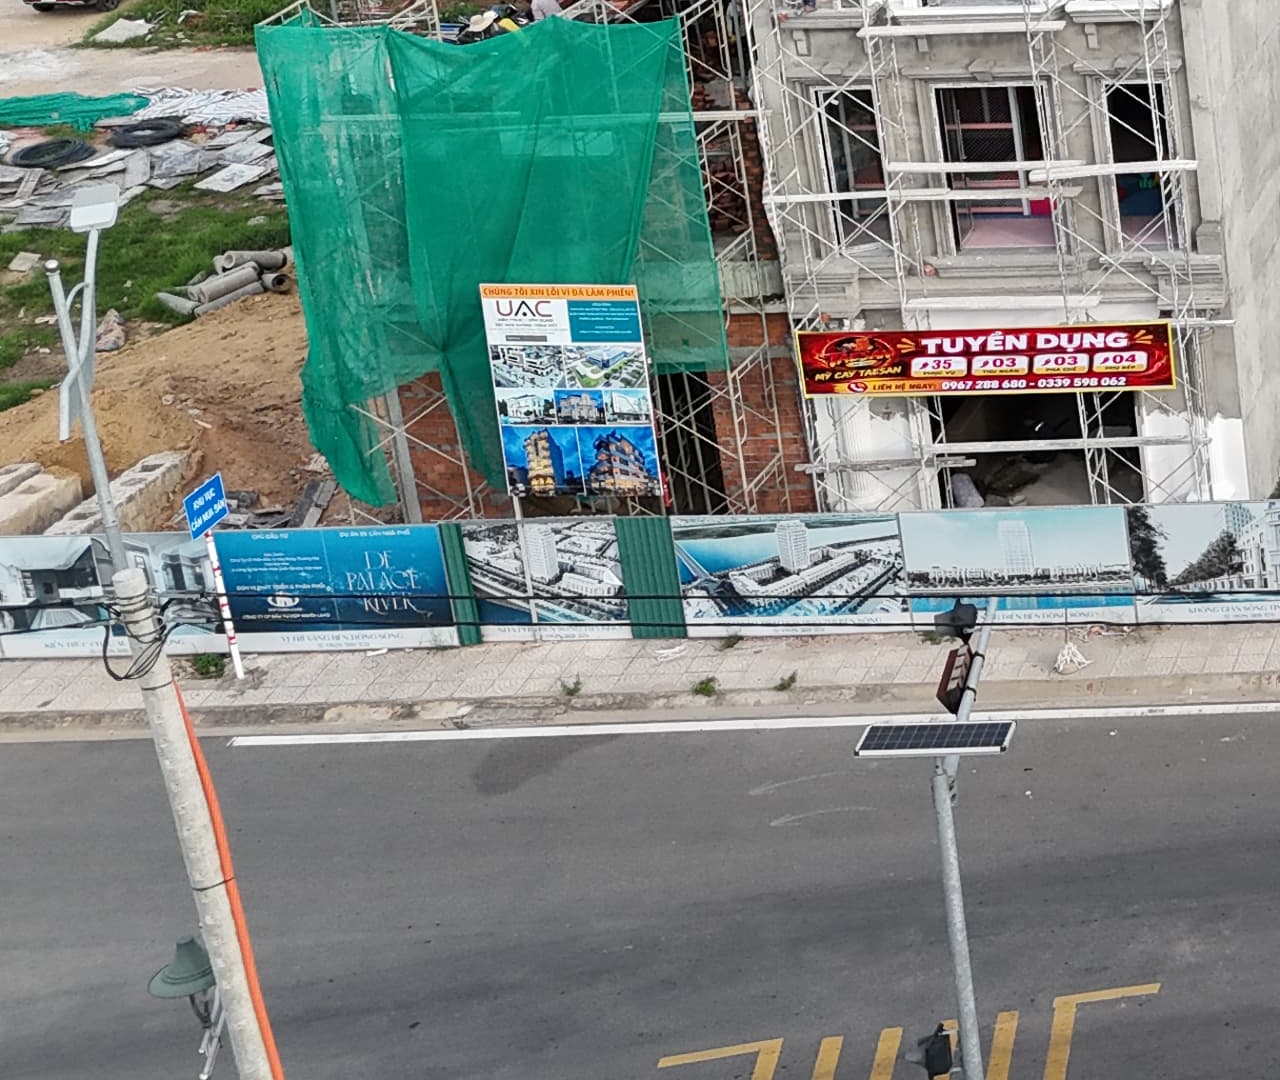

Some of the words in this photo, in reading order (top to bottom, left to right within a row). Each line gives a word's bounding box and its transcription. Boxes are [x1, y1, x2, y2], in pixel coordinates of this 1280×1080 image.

[483, 287, 512, 296] CHÚNG
[514, 287, 528, 296] TÔI
[530, 288, 544, 296] XIN
[586, 288, 604, 298] LÀM
[496, 300, 553, 318] UAC
[921, 331, 1027, 354] TUYỂN
[1036, 331, 1128, 352] DỤNG
[931, 359, 952, 369] 35
[992, 358, 1016, 367] 03
[1054, 356, 1078, 366] 03
[1112, 354, 1136, 364] 04
[834, 370, 854, 380] CAY
[942, 380, 970, 390] 0967
[974, 380, 999, 389] 288
[1002, 379, 1026, 388] 680
[1038, 378, 1070, 388] 0339
[1074, 377, 1098, 386] 598
[1101, 377, 1126, 386] 062
[364, 550, 394, 570] DE
[346, 568, 422, 591] PALACE
